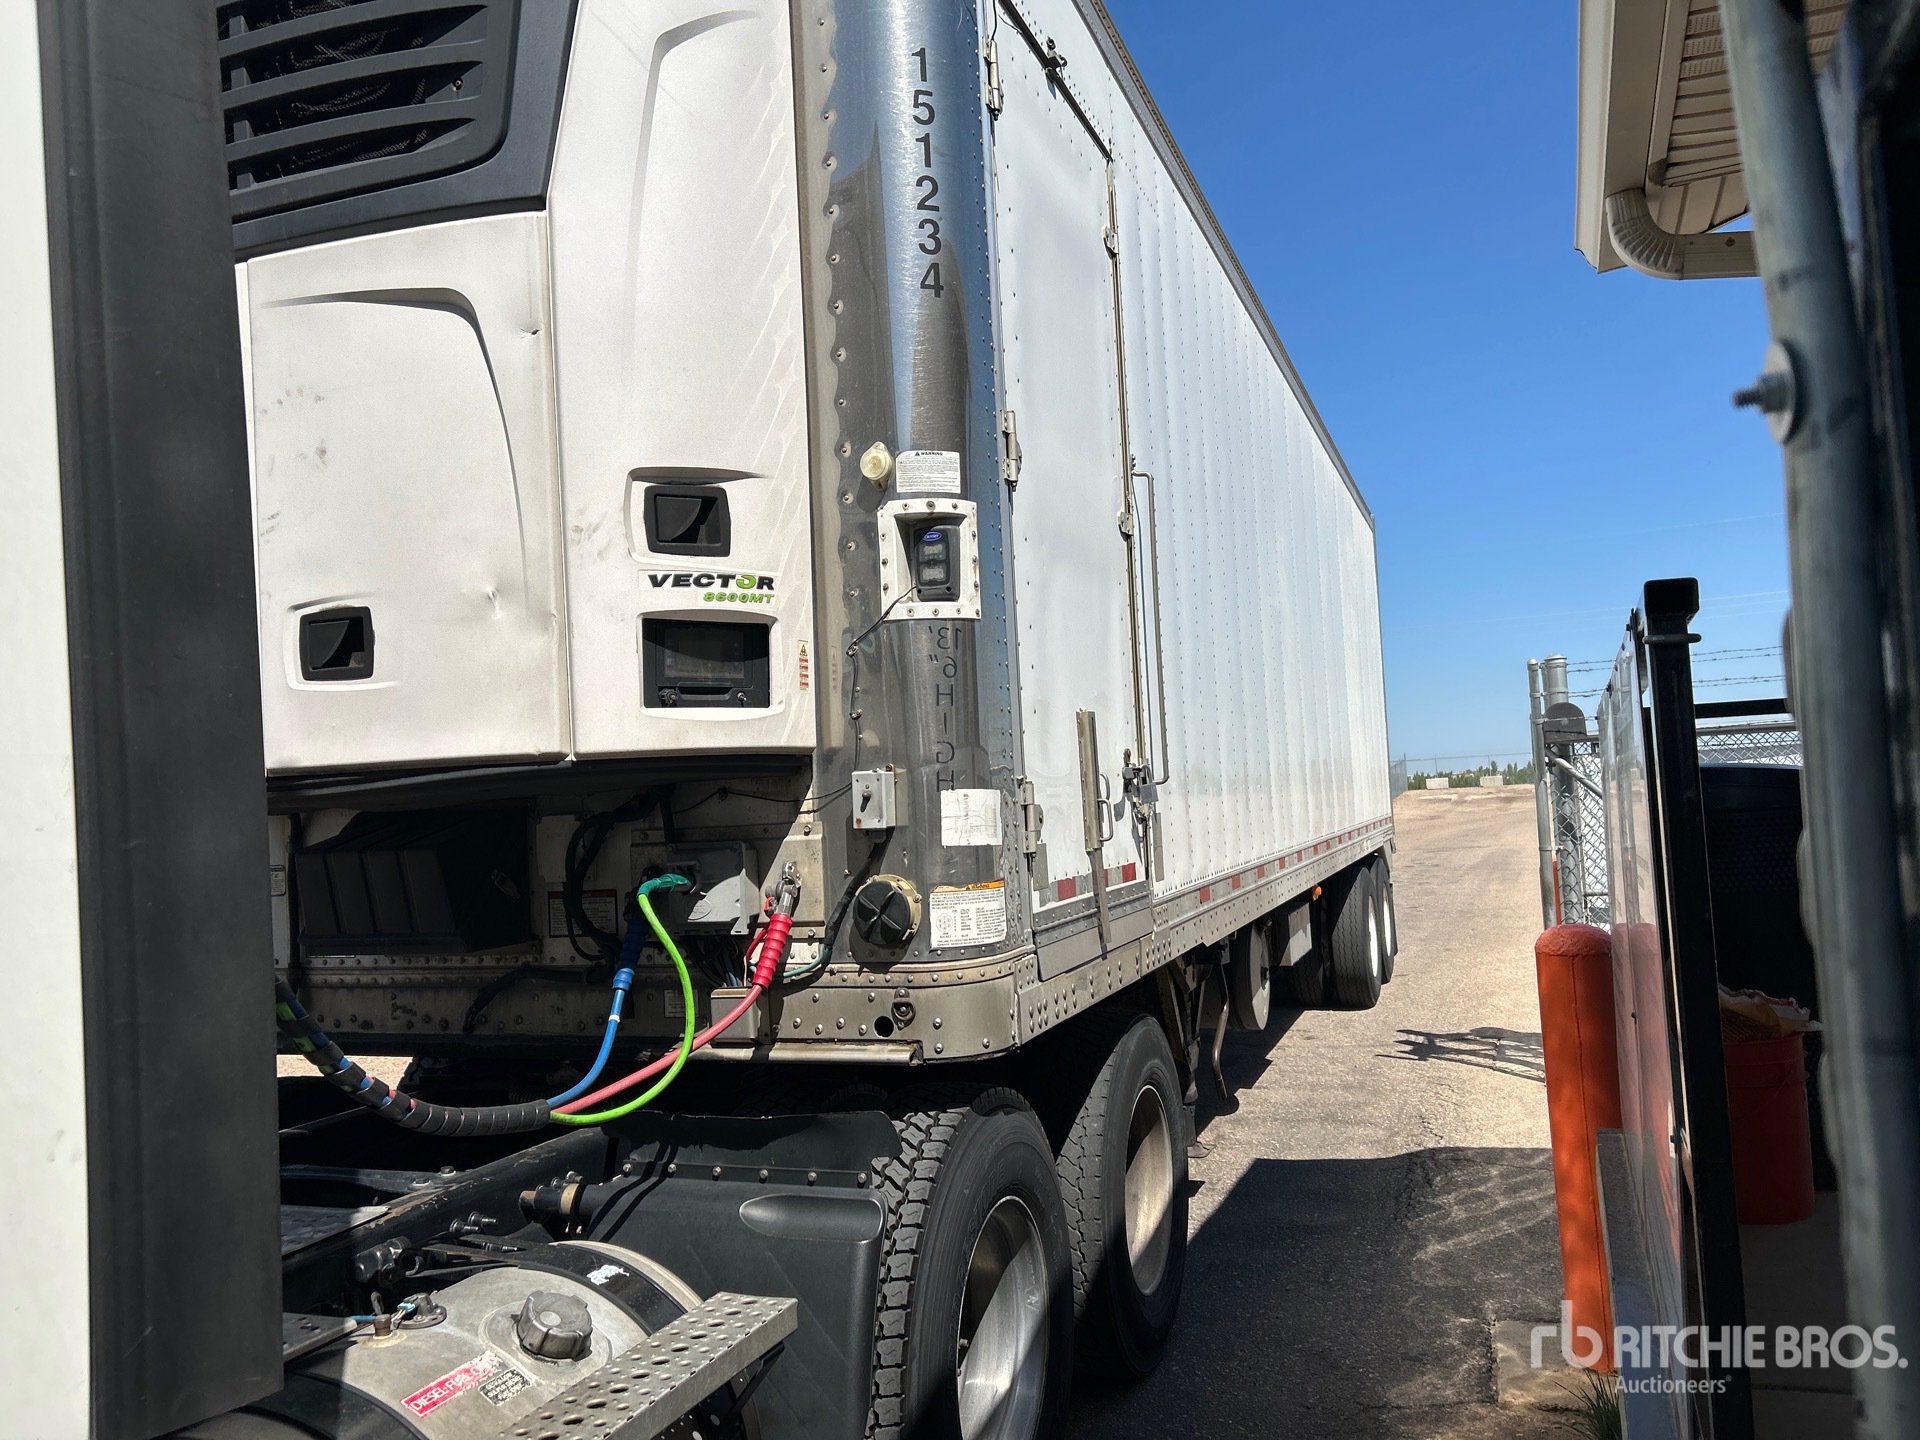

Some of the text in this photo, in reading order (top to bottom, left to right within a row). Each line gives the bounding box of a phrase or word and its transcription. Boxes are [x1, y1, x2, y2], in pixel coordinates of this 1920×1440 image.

[911, 47, 945, 299] 151234
[647, 573, 775, 590] VECTOR
[702, 592, 775, 604] 8600MT
[409, 1386, 450, 1411] DIESEL
